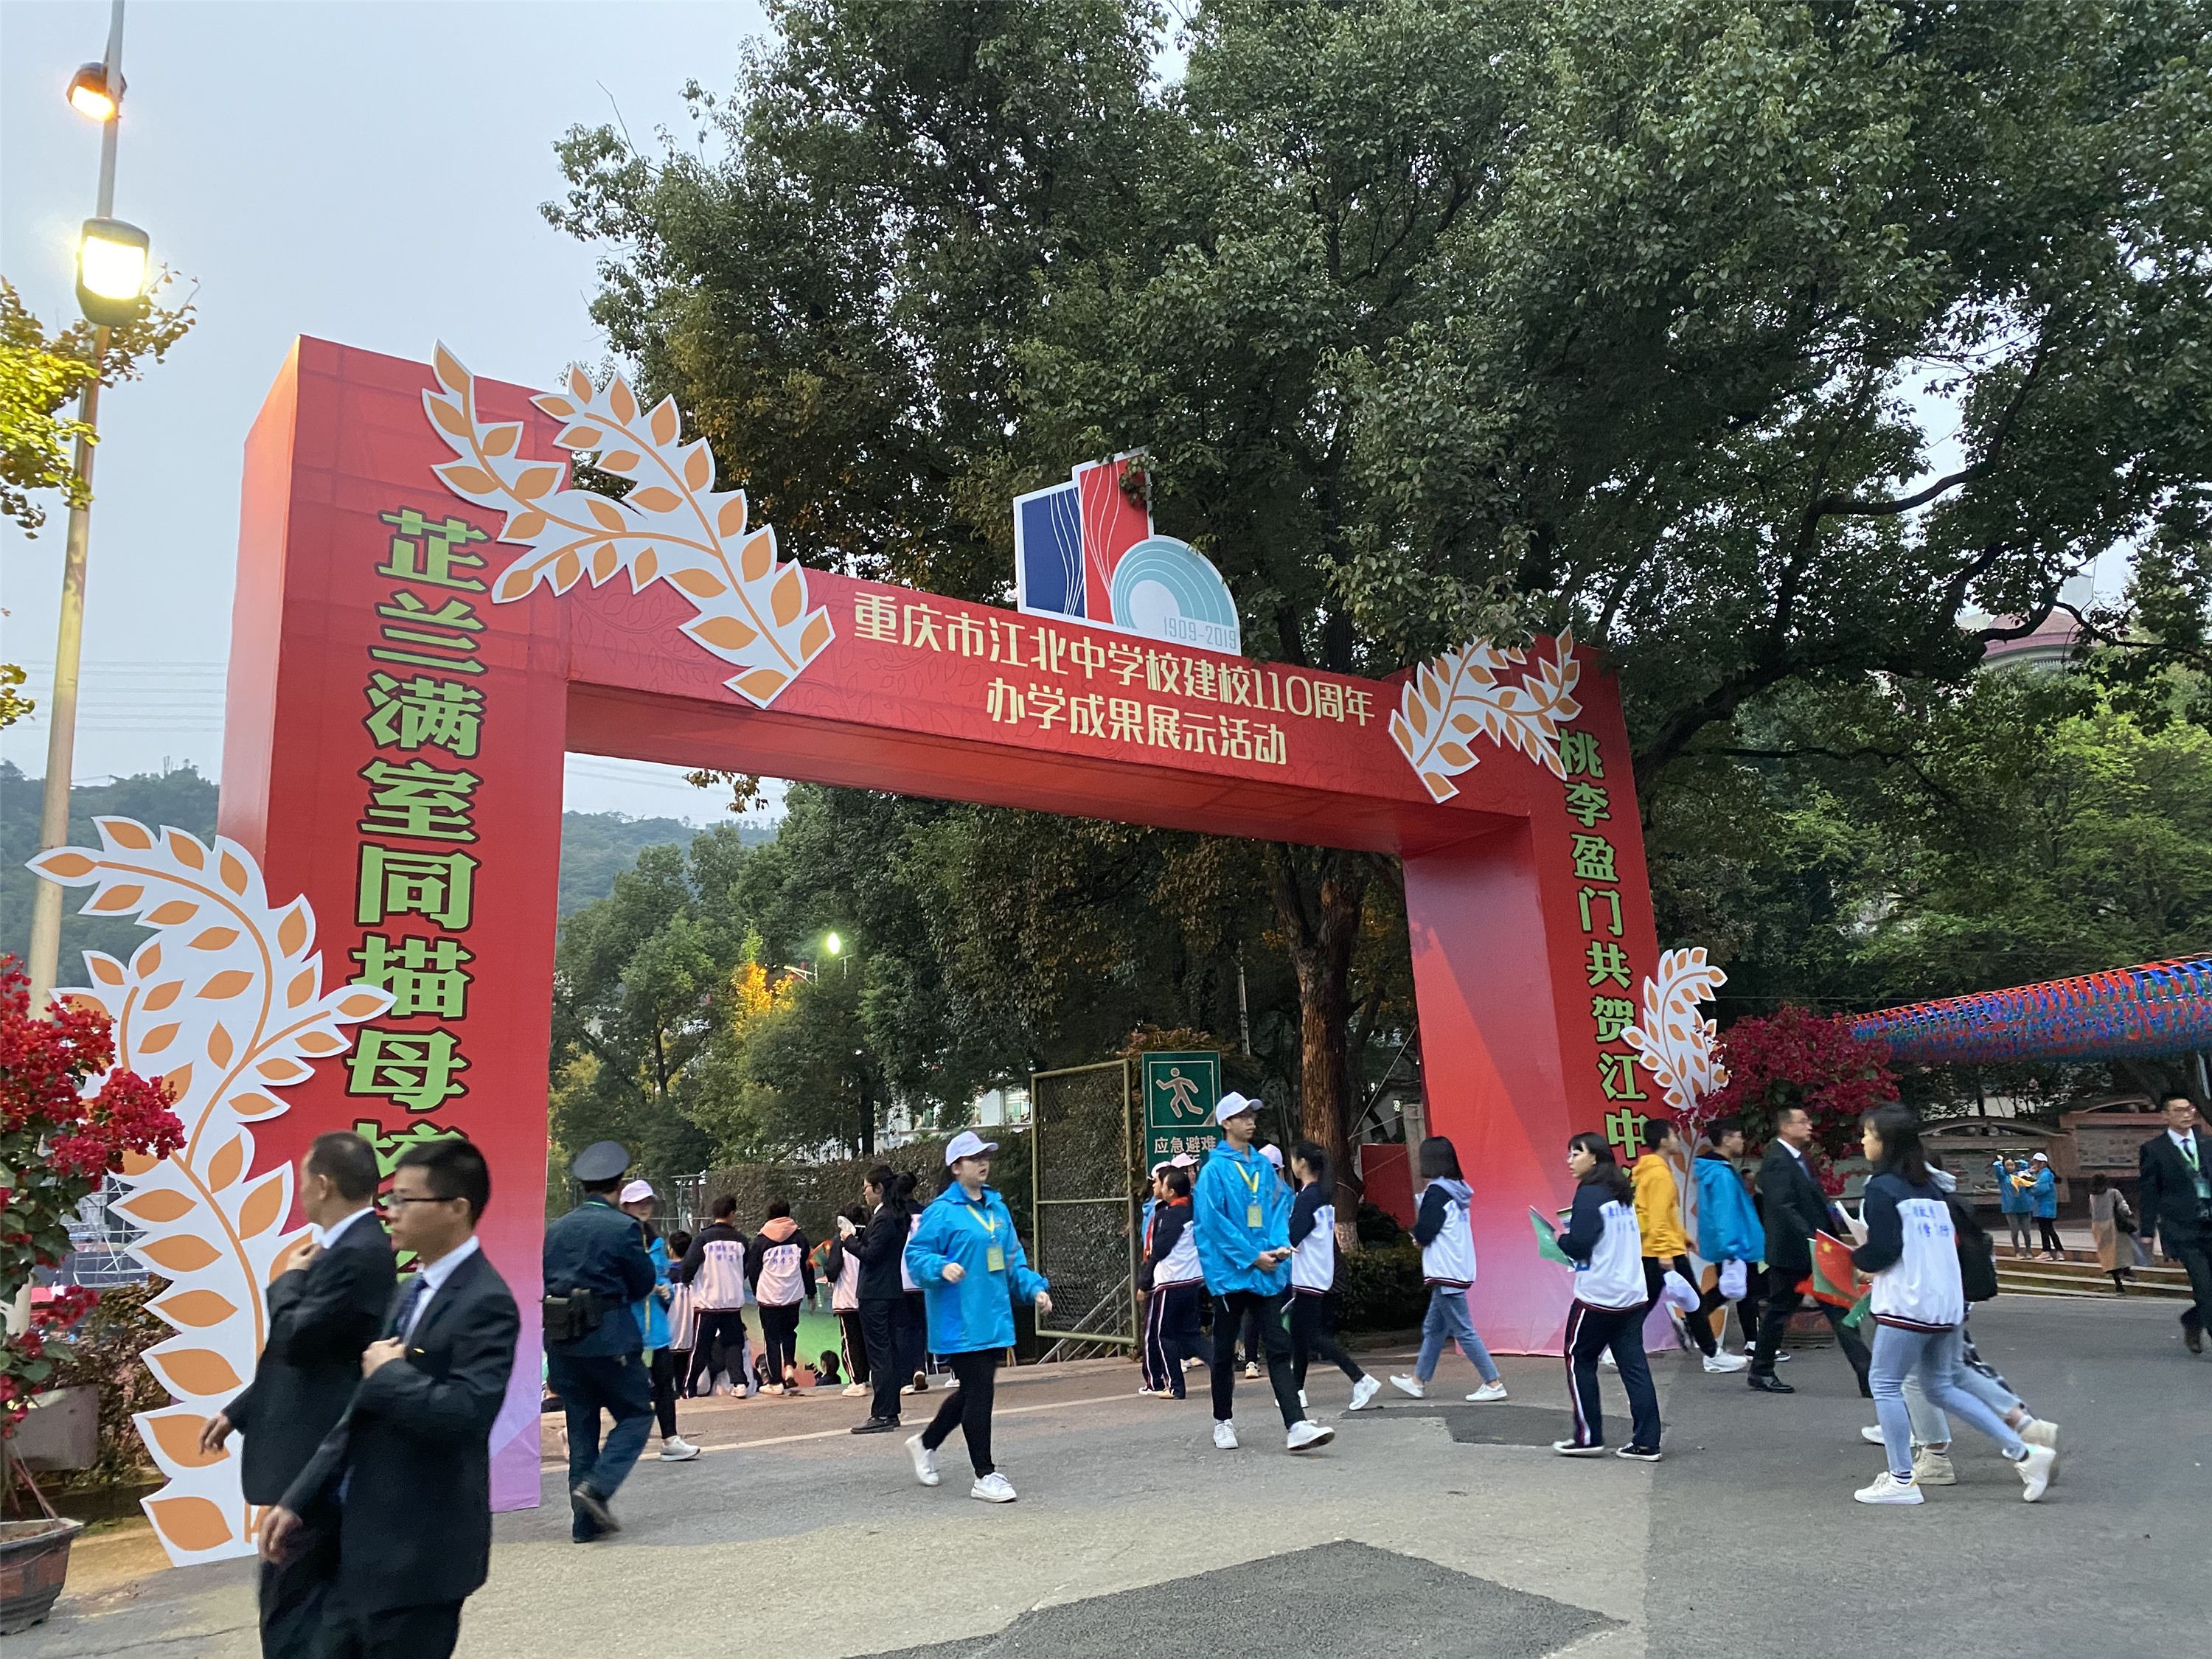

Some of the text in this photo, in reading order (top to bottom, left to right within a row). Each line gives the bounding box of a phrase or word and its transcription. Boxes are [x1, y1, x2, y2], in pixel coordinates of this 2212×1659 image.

[853, 591, 1376, 727] 重庆市江北中学校建校110周年
[1164, 616, 1237, 650] 1909-2019
[986, 677, 1287, 765] 办学成果展示活动
[347, 506, 493, 1284] 芷兰满室同描母
[1557, 727, 1650, 1189] 桃李盈门共贺江中
[1154, 1135, 1217, 1154] 应急避难
